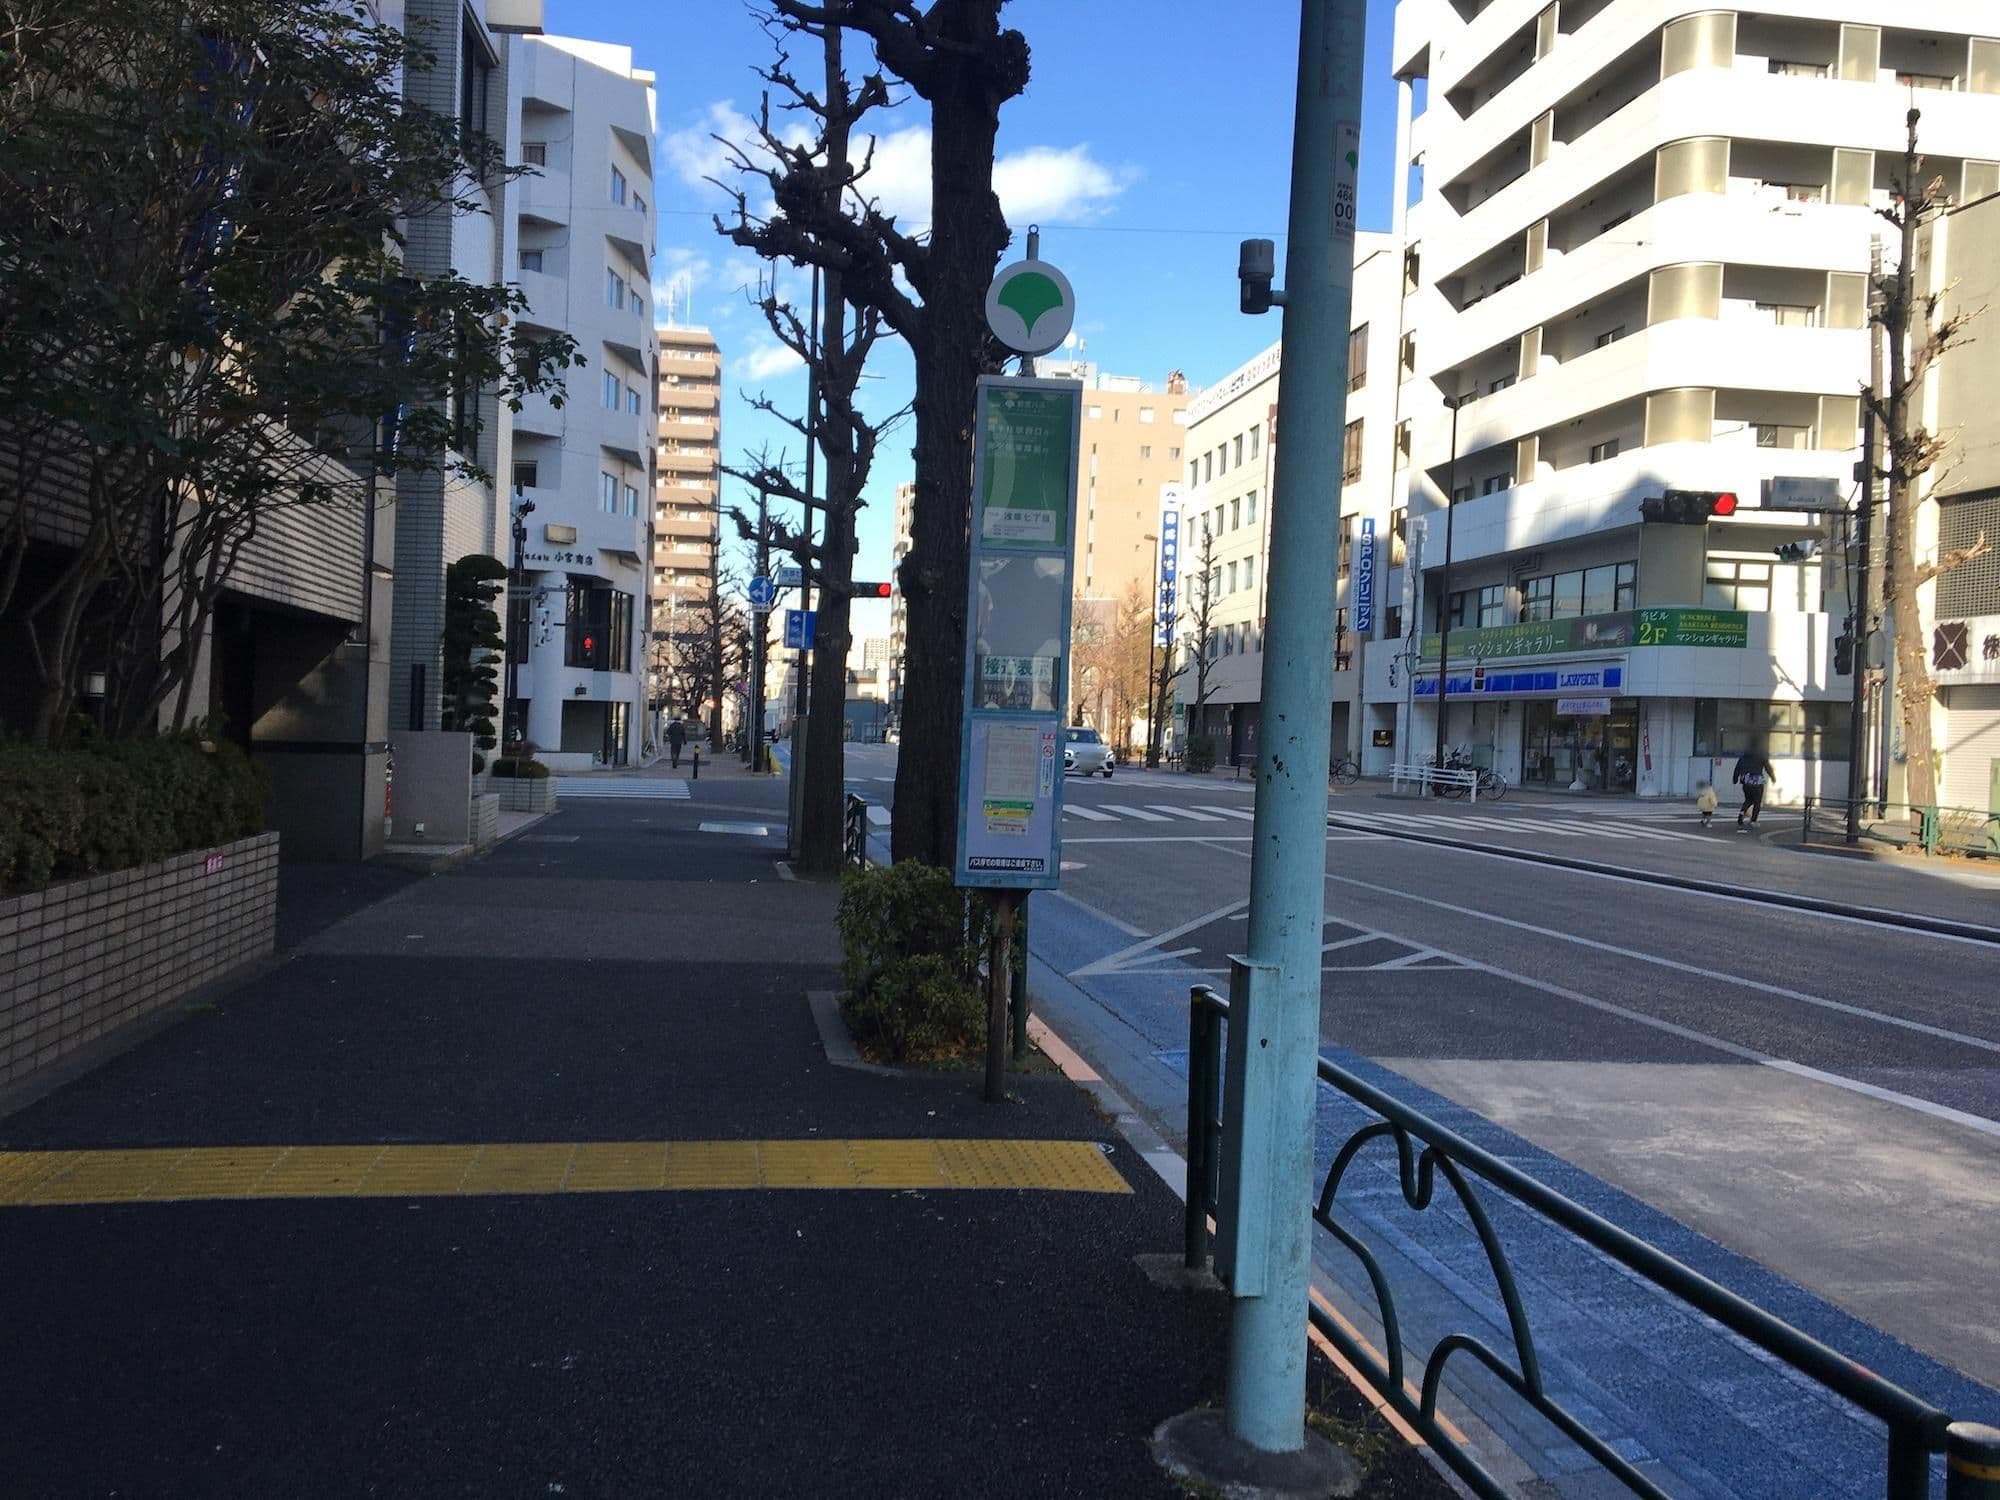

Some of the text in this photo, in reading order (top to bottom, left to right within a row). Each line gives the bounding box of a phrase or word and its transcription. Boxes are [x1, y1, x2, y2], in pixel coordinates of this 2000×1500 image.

[1639, 622, 1668, 644] 2F
[1467, 634, 1566, 656] マンションギャラリー
[1560, 672, 1600, 687] LAWSON
